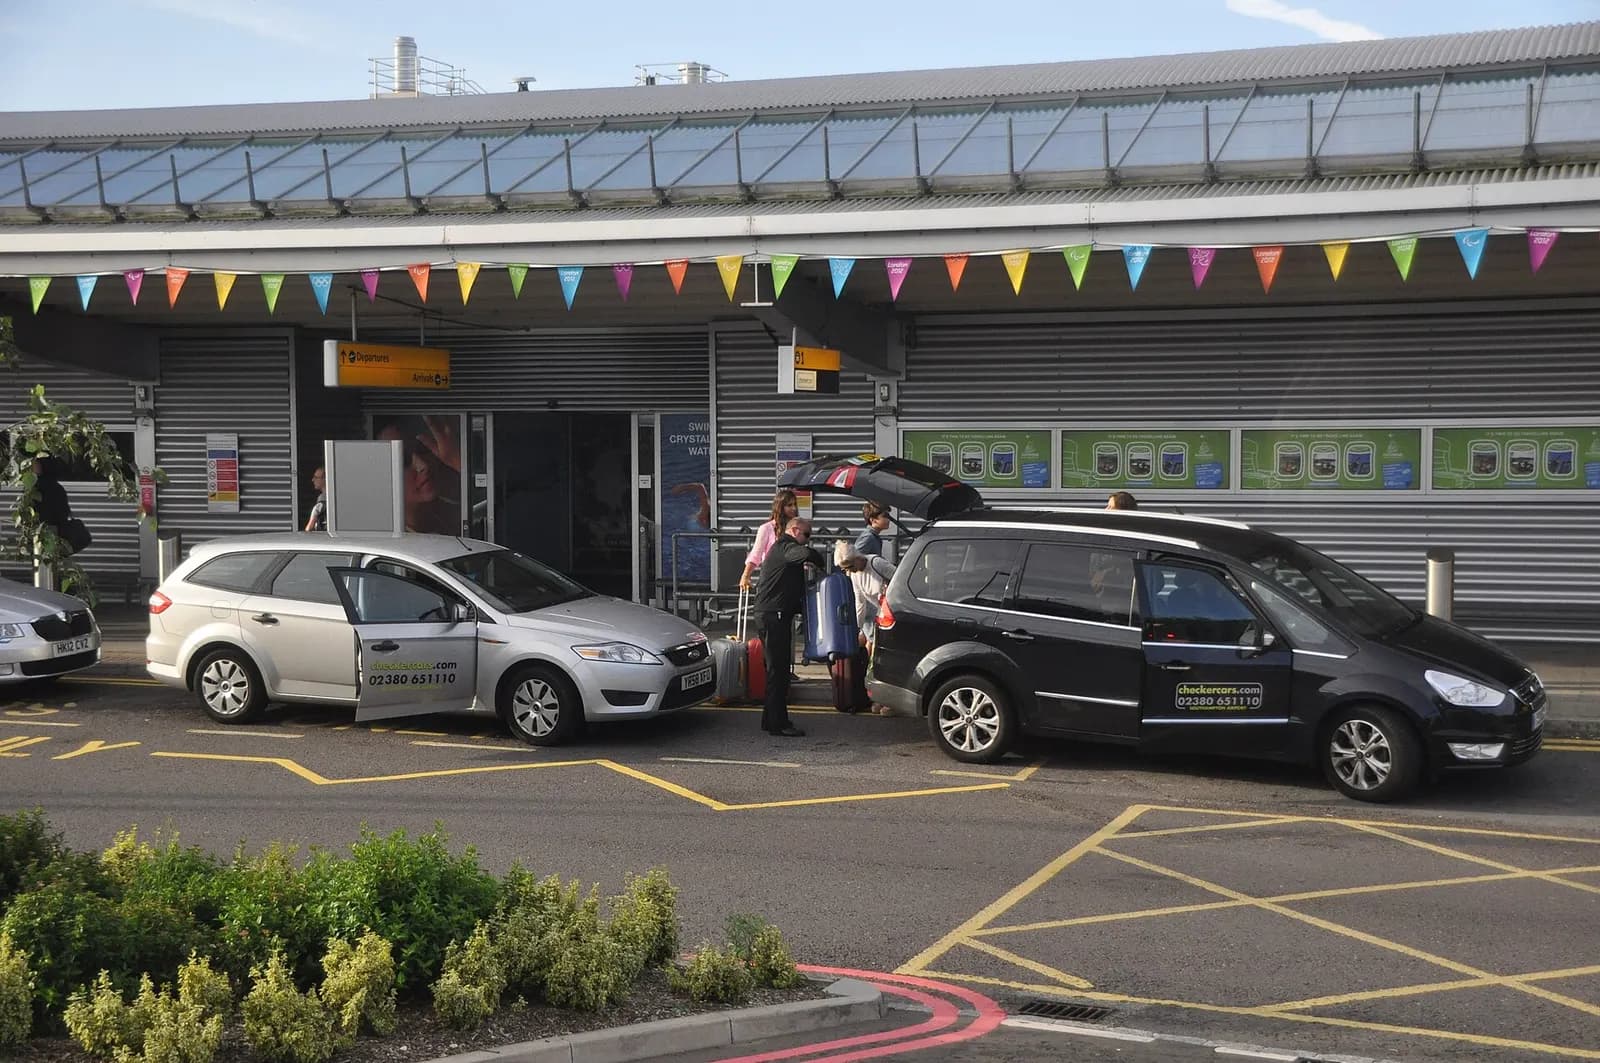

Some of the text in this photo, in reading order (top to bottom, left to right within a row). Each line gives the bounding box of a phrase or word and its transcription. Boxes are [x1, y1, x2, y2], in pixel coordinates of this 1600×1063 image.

[356, 351, 390, 364] Departures
[413, 373, 434, 384] Arrivals
[688, 422, 710, 431] SWI
[669, 434, 710, 444] CRYSTAL
[688, 447, 710, 456] WAT
[369, 673, 456, 686] 02380 651110
[1178, 685, 1260, 694] checkercars.com
[1178, 697, 1260, 706] 02380 651110
